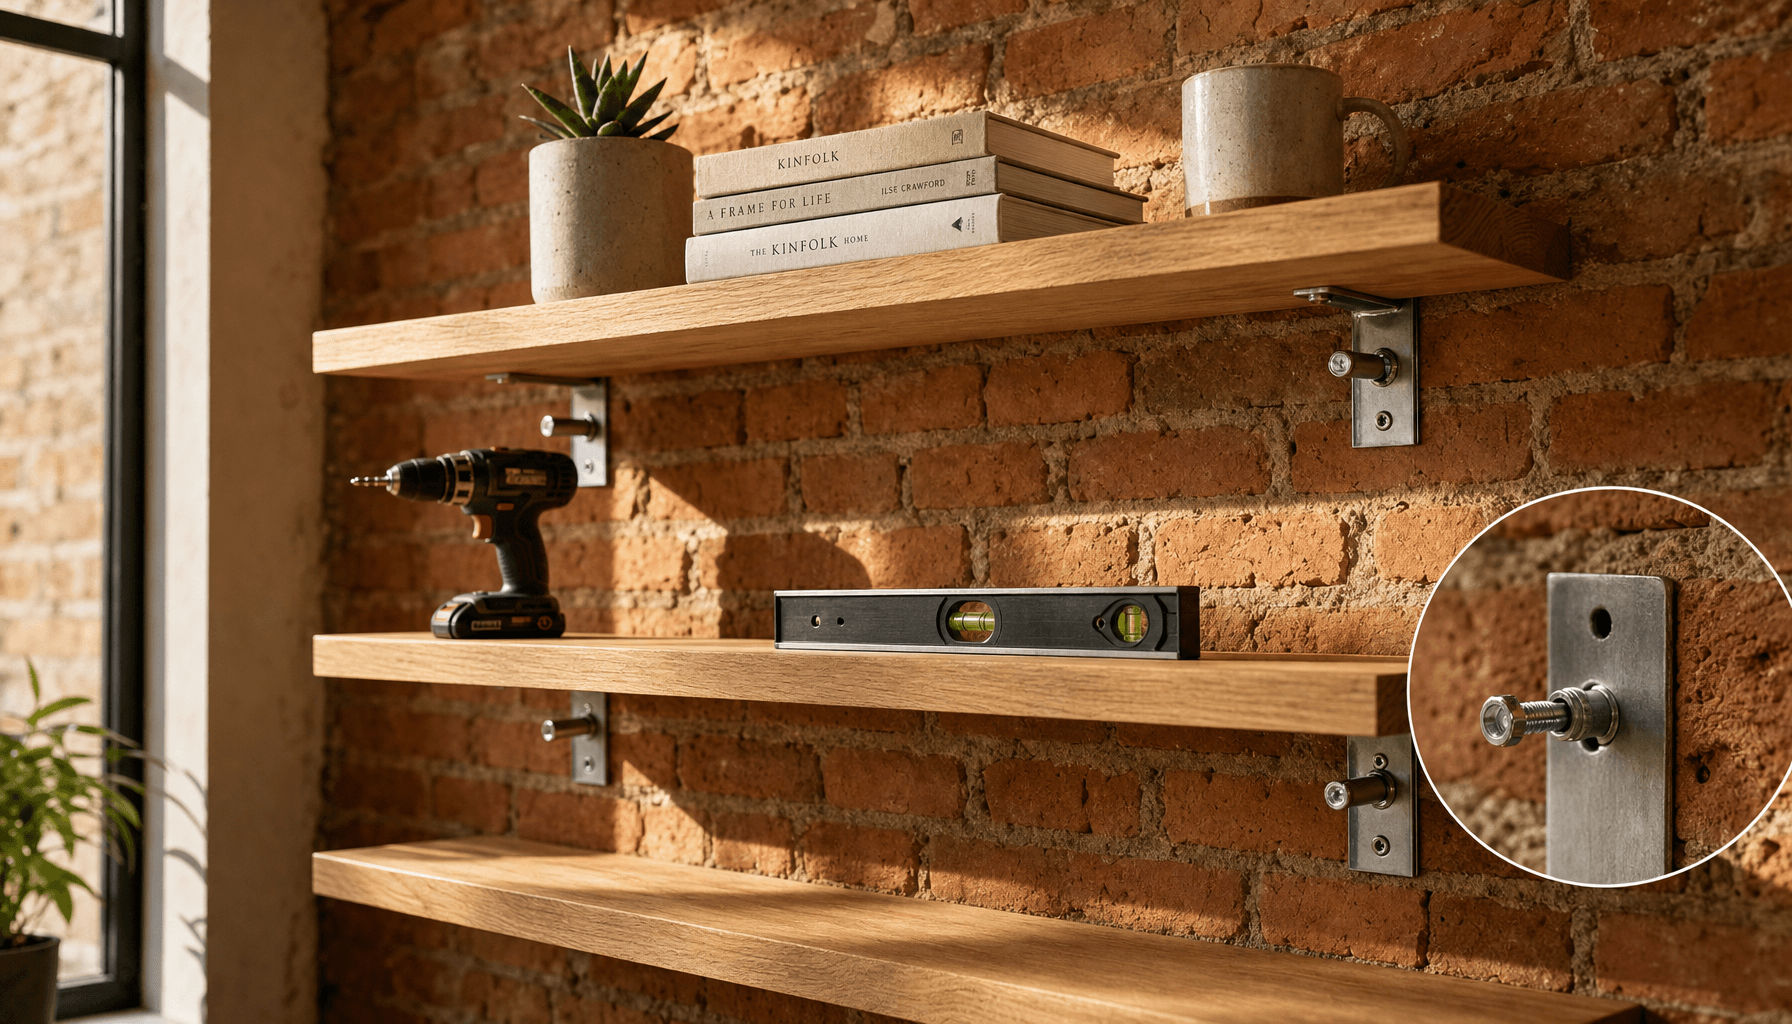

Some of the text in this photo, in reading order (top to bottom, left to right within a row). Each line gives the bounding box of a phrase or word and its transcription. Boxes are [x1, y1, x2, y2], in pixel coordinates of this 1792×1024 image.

[778, 150, 839, 170] KINFOLK
[881, 179, 945, 195] ILSE CRAWFORD
[707, 193, 831, 220] A FRAME FOR LIFE
[750, 235, 868, 257] THE KINFOLK HOME
